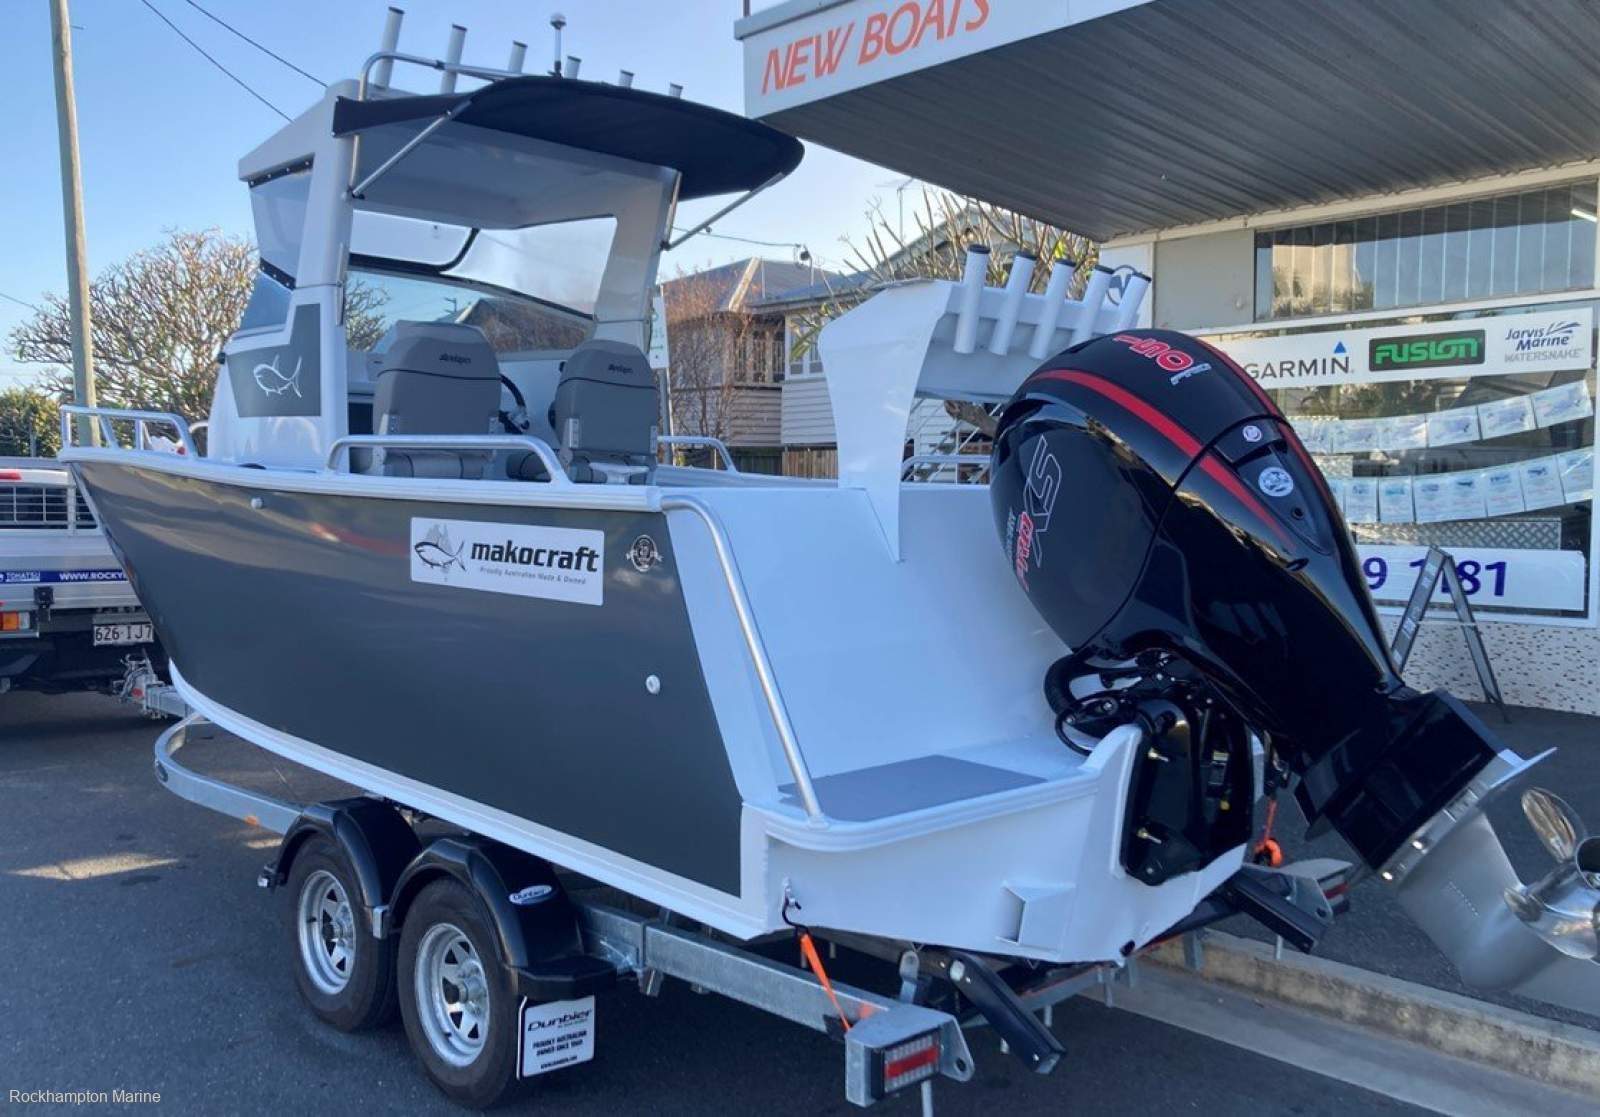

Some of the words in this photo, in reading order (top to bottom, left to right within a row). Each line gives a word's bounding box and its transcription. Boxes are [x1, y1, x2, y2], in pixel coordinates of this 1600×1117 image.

[761, 22, 855, 95] NEW
[857, 0, 990, 65] BOATS
[1505, 328, 1545, 341] Jarvis
[1516, 336, 1569, 351] Marine
[1504, 348, 1584, 362] WATERSNAKE
[1244, 356, 1350, 380] GARMIN
[470, 540, 600, 572] makocraft
[527, 1009, 590, 1032] Dunbier
